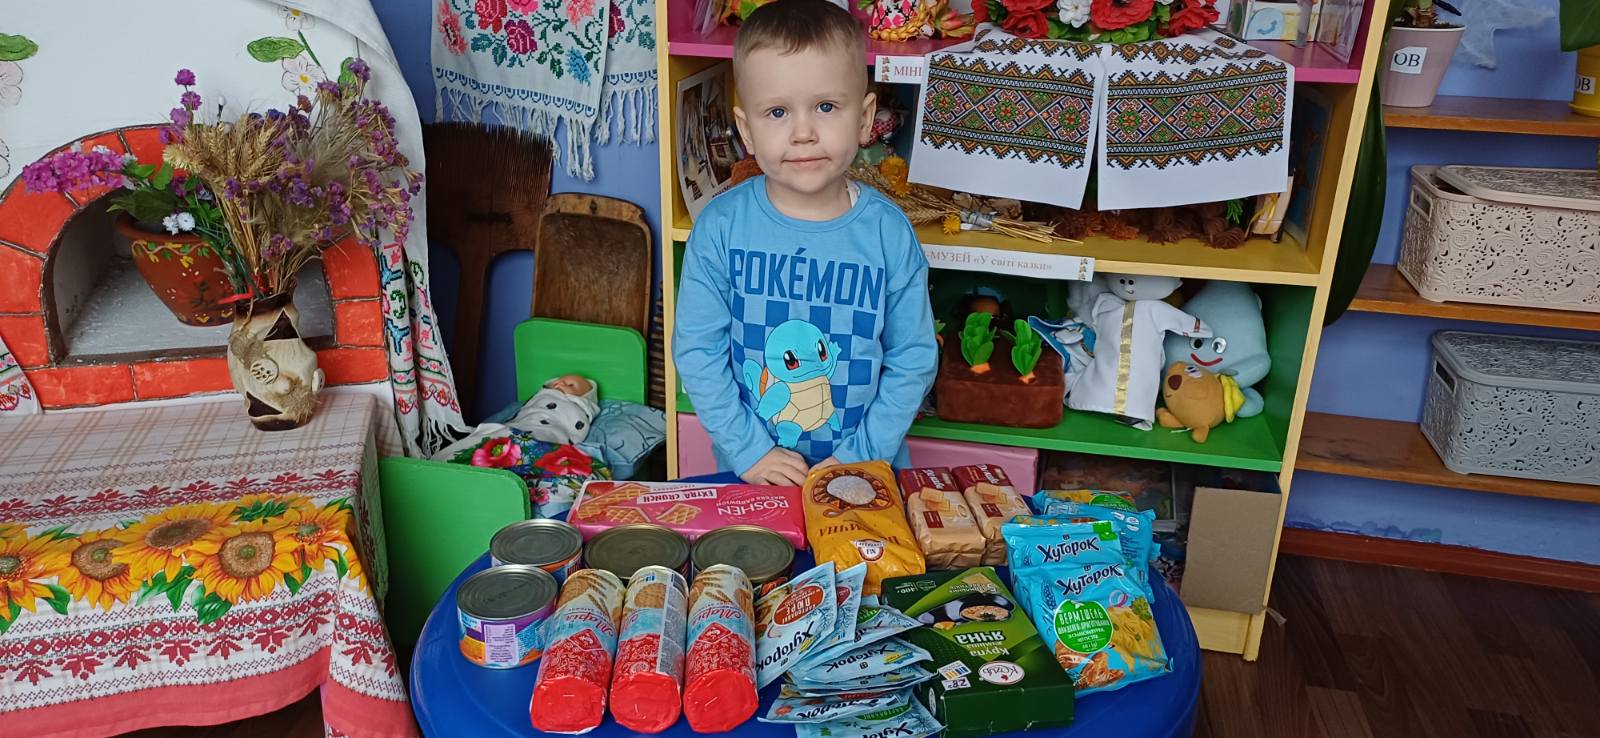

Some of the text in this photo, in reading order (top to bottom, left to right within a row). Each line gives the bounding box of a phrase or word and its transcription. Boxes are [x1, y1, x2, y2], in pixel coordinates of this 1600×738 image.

[729, 248, 884, 311] POKÉMON
[643, 489, 714, 502] EXTRA CRUNCH
[718, 500, 789, 516] ROSHEN
[1037, 537, 1099, 562] Хуторок
[1056, 564, 1122, 595] Хуторок
[786, 597, 811, 615] ПЮРЕ
[1060, 608, 1104, 625] ВЕРМІШЕЛЬ
[755, 621, 814, 673] Хуторок
[970, 646, 1009, 656] Крупа
[823, 644, 896, 673] Хуторок
